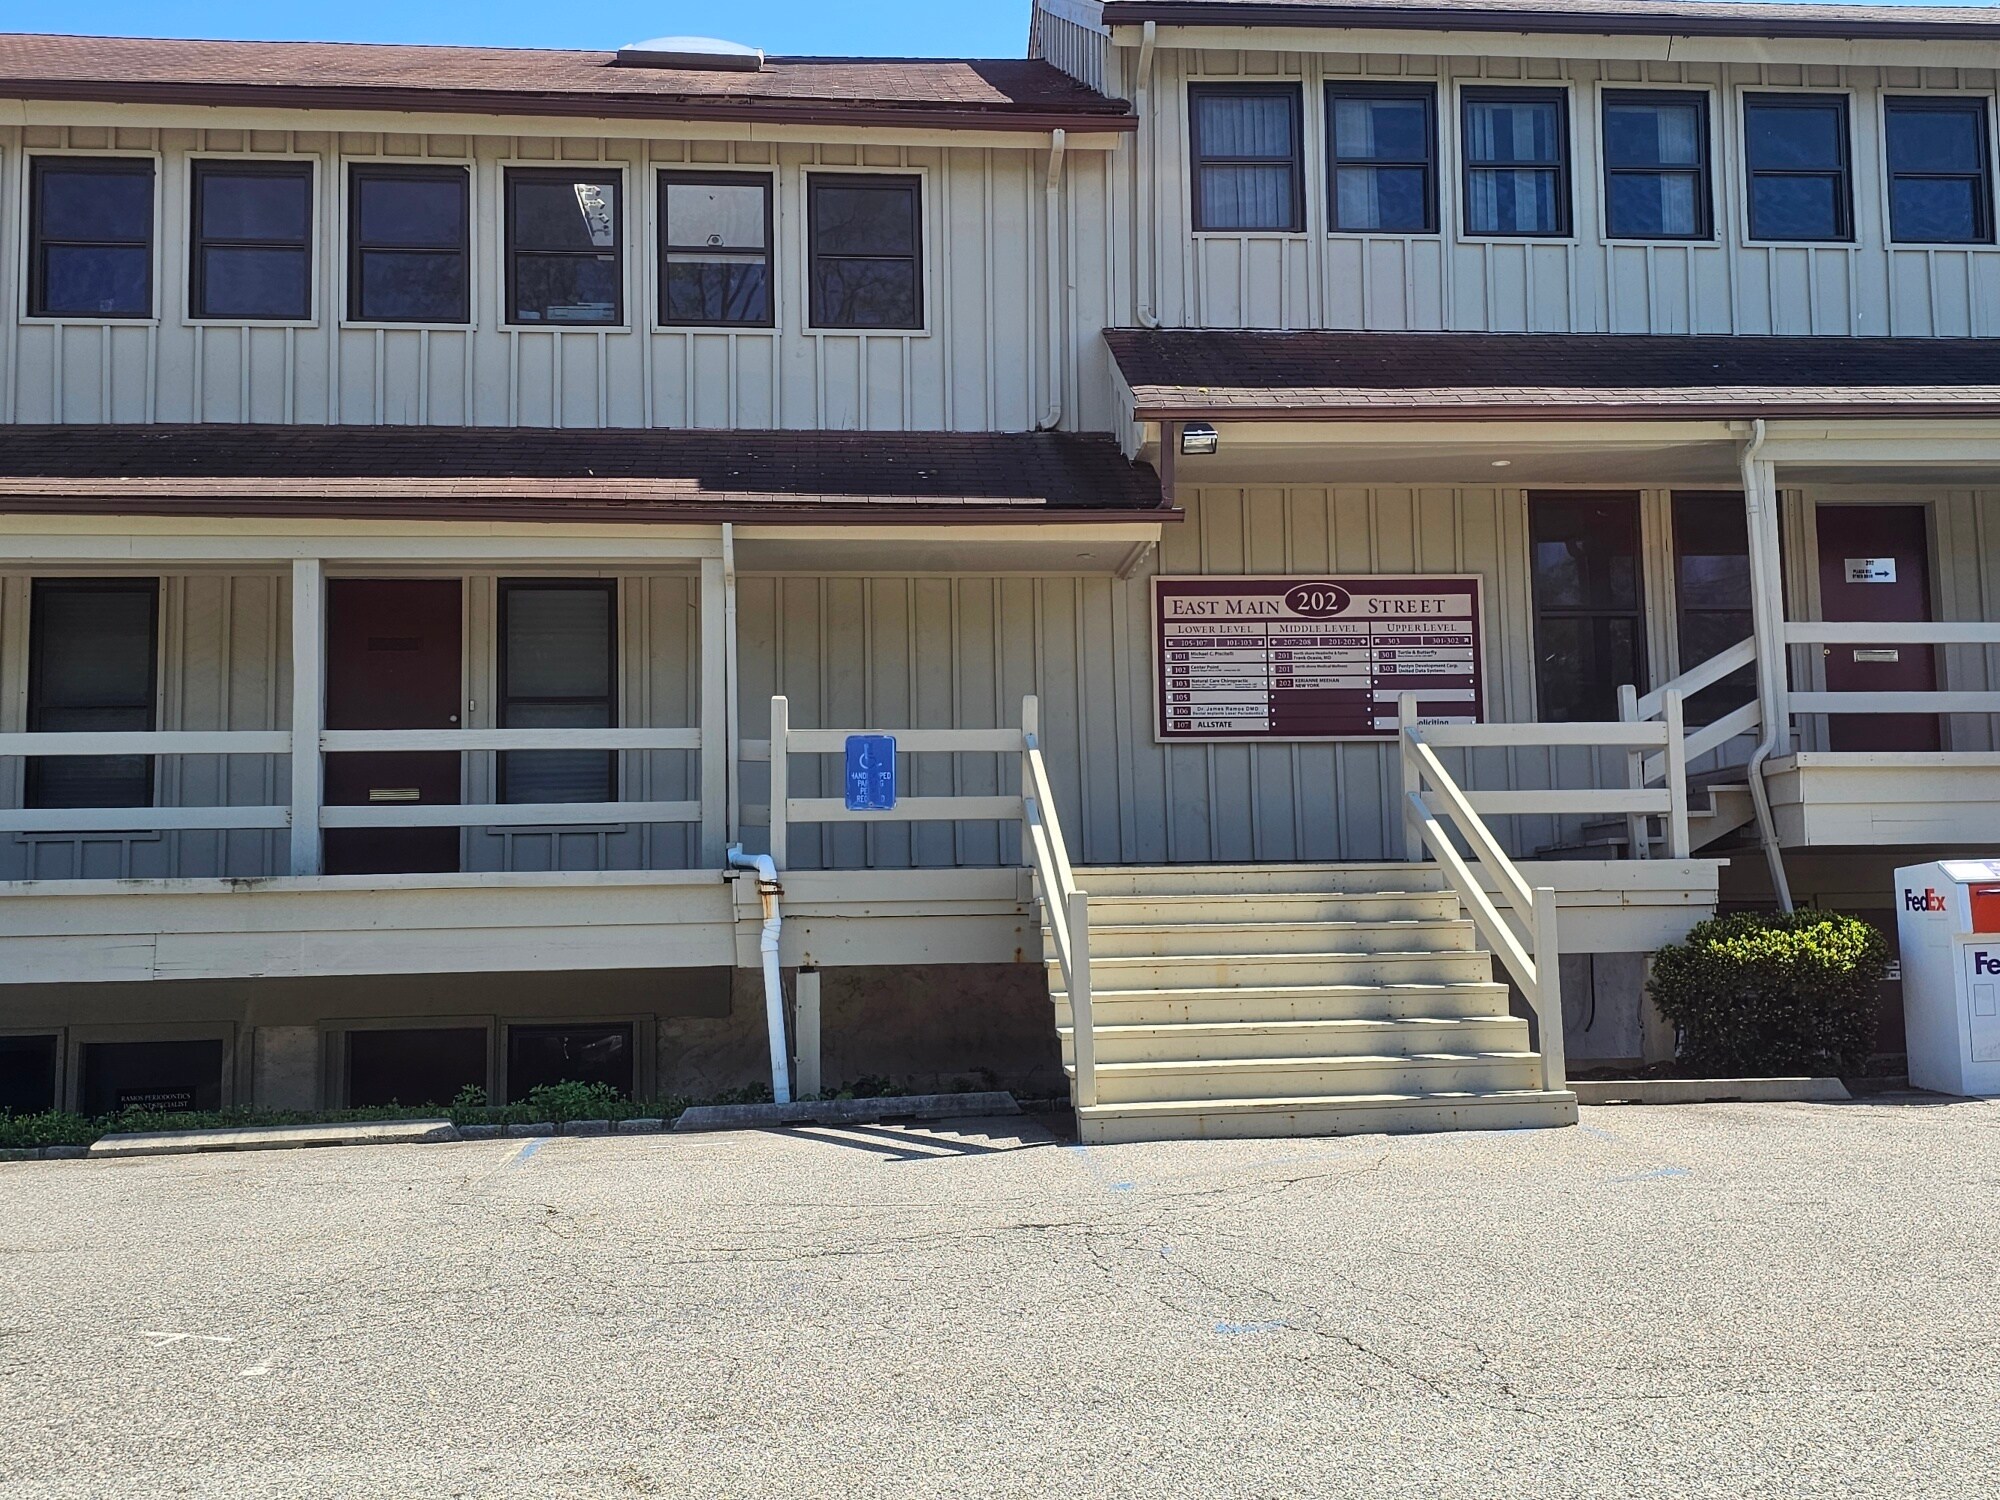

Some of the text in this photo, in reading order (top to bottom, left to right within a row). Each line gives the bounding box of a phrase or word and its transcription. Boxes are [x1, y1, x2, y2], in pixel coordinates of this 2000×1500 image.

[1172, 600, 1280, 615] EAST MAIN
[1297, 592, 1338, 611] 202
[1368, 598, 1446, 614] STREET
[1178, 624, 1254, 634] LOWER LEVEL
[1280, 624, 1358, 632] MIDDLE LEVEL
[1387, 623, 1457, 632] UPPER LEVEL
[1904, 888, 1946, 911] FedEx
[145, 1092, 190, 1101] PERIODONTICS
